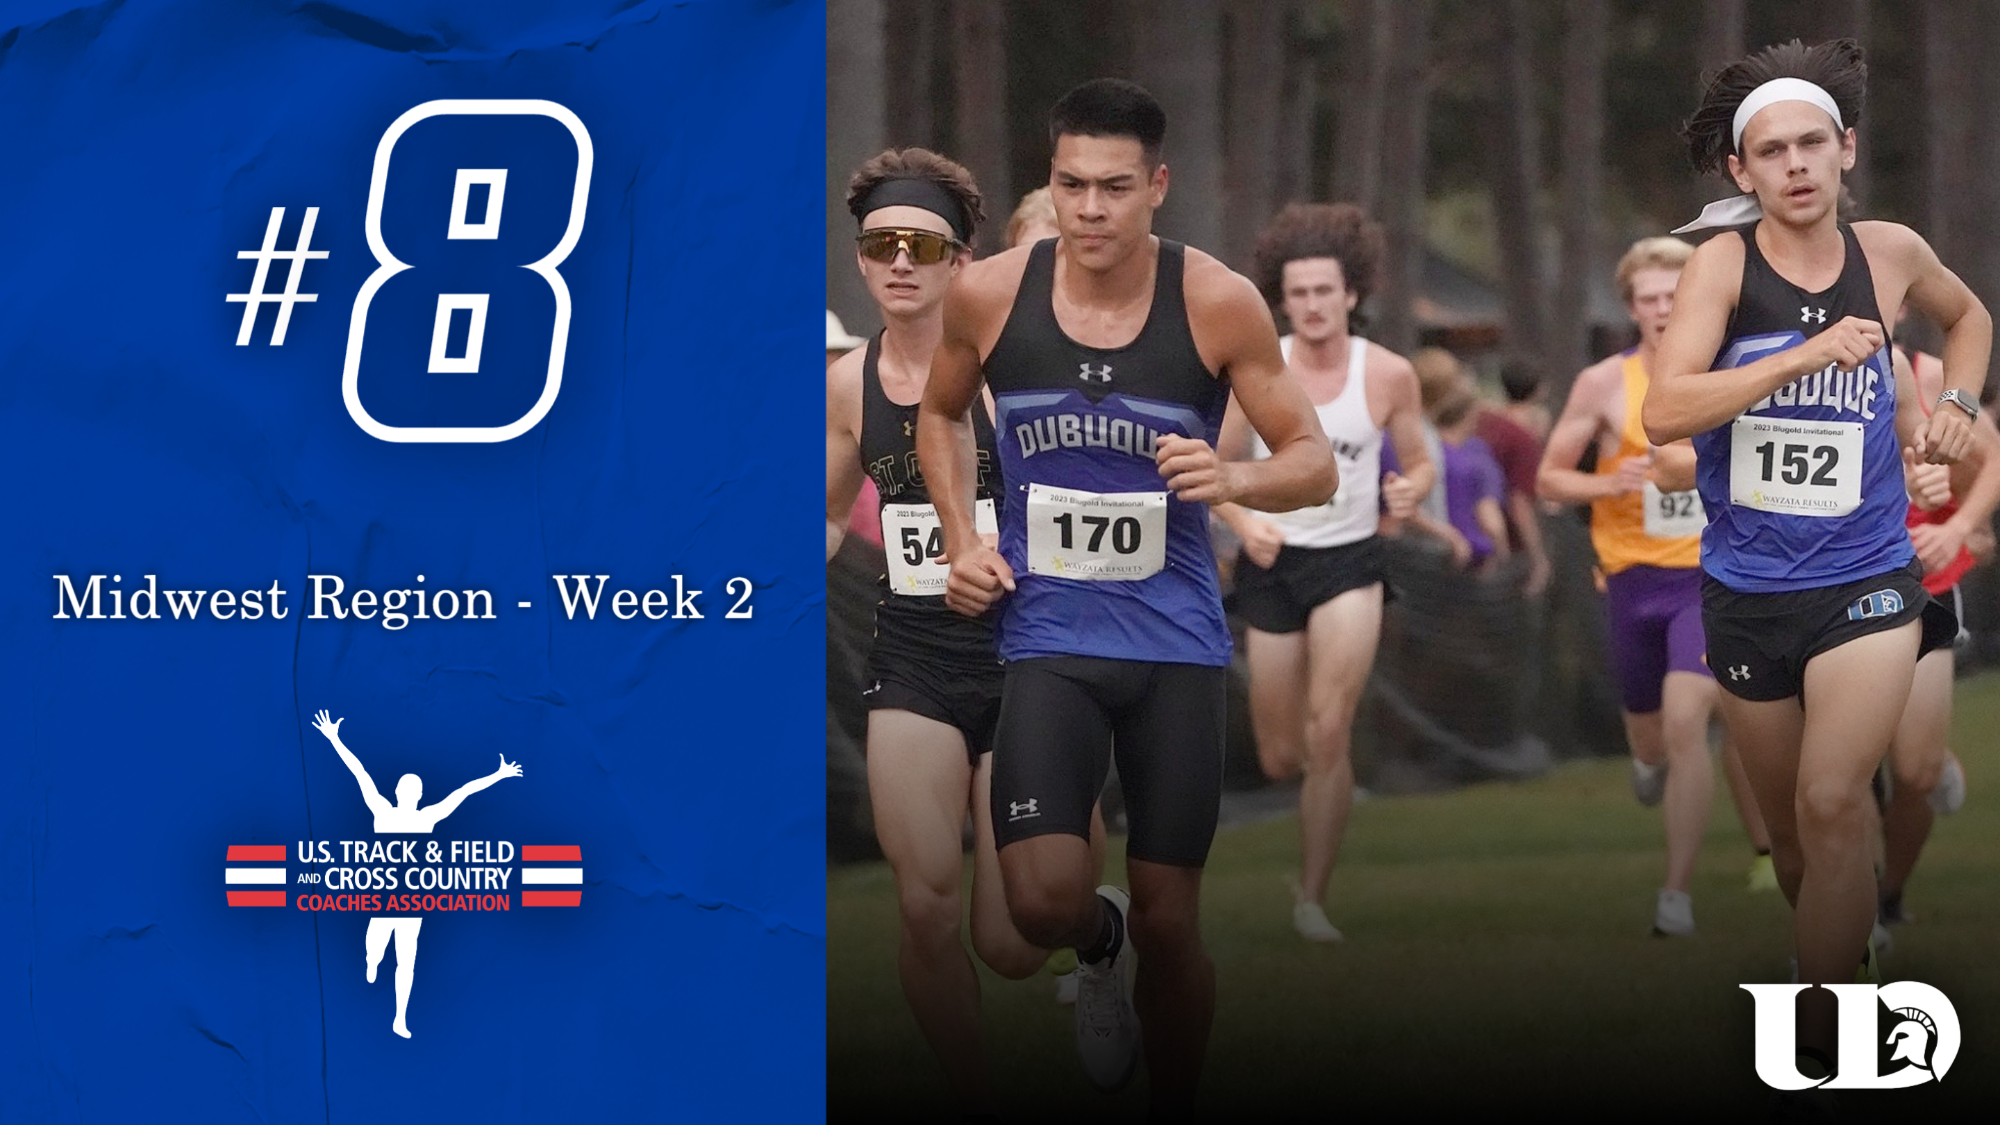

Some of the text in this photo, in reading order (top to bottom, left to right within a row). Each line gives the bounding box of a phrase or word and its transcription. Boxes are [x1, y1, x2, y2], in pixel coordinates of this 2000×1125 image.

[1015, 413, 1159, 460] DUBUQU
[1753, 424, 1844, 436] 2023 Blugold Invitational
[1756, 441, 1839, 487] 152
[1050, 494, 1068, 504] 2023
[1069, 497, 1099, 507] Blugold
[1763, 495, 1800, 505] WAYZATA
[1802, 499, 1838, 508] RESULTS
[911, 511, 935, 519] Blugold
[1053, 512, 1141, 554] 170
[1064, 561, 1103, 573] WAYZATA
[1105, 565, 1143, 573] RESULTS
